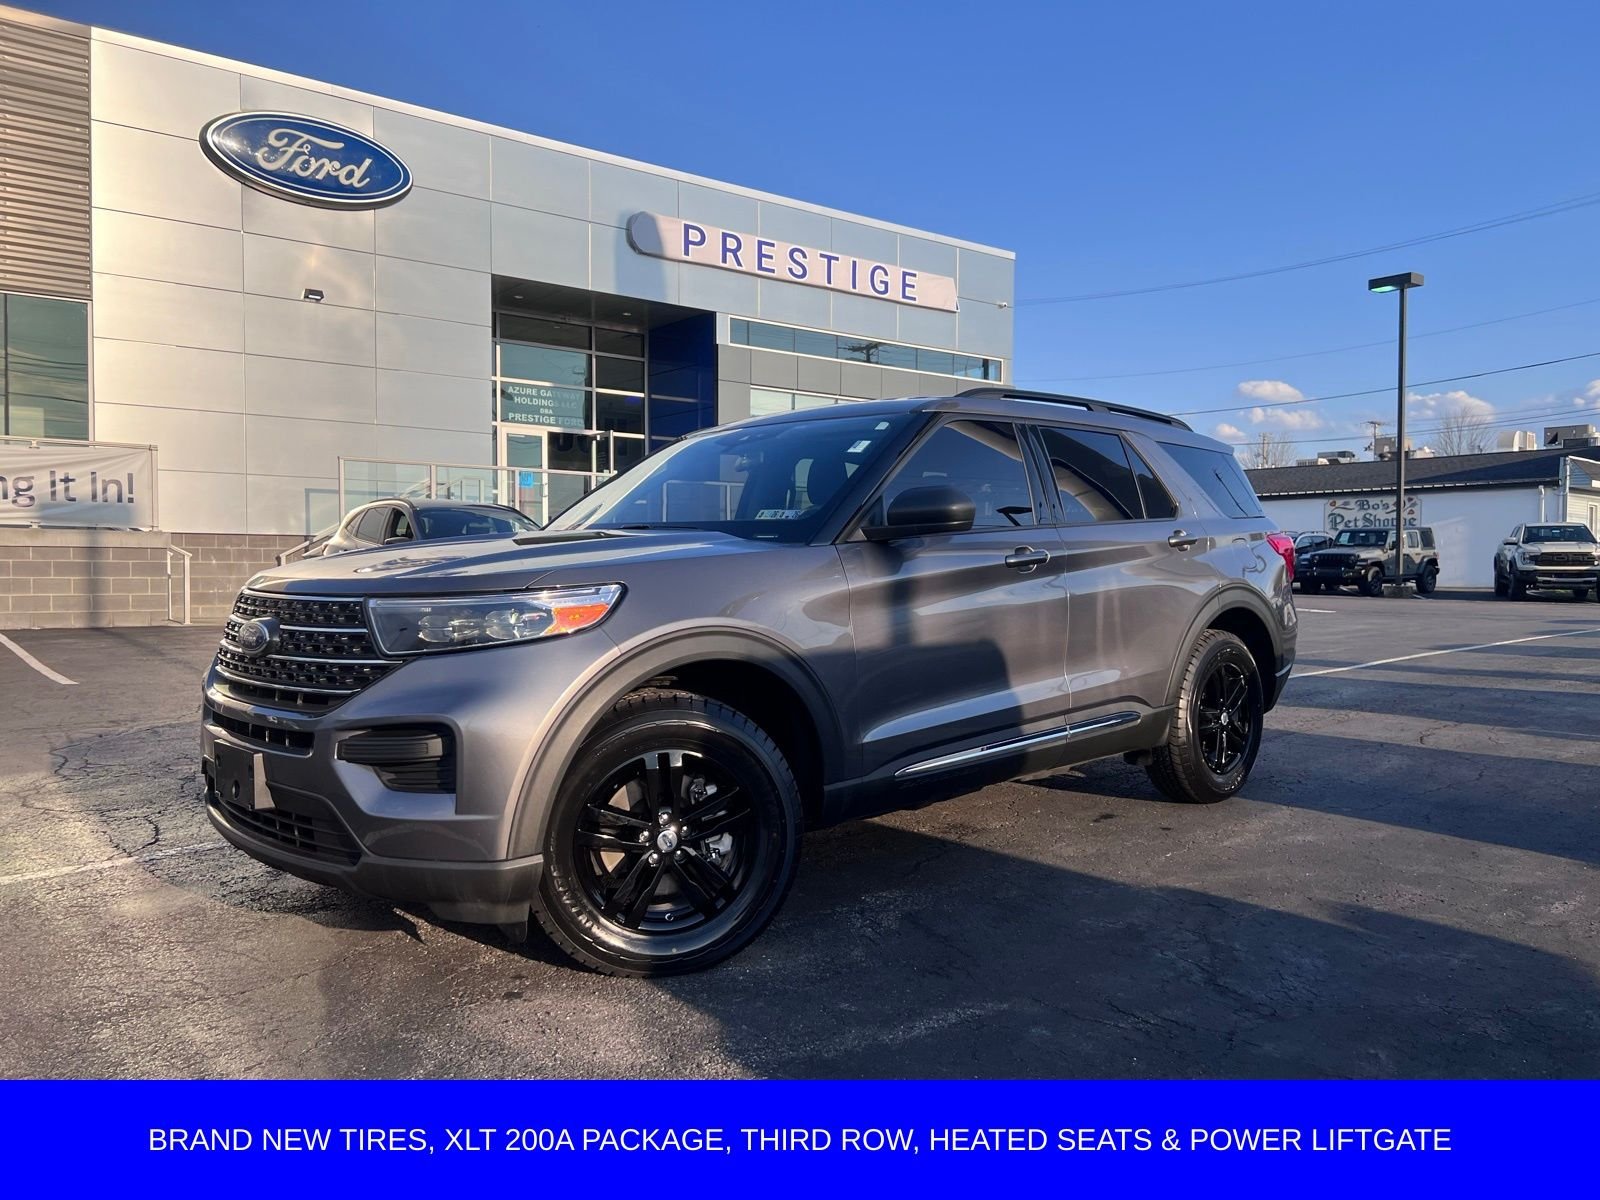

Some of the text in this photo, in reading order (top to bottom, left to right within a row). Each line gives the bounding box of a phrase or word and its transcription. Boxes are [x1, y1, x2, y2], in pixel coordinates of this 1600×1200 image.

[256, 128, 373, 188] Ford
[682, 222, 918, 302] PRESTIGE
[507, 386, 538, 396] AZURE
[508, 412, 556, 424] PRESTIGE
[49, 470, 77, 502] It
[90, 471, 135, 504] In!
[1355, 499, 1390, 512] Bo's
[1328, 512, 1360, 531] Pet
